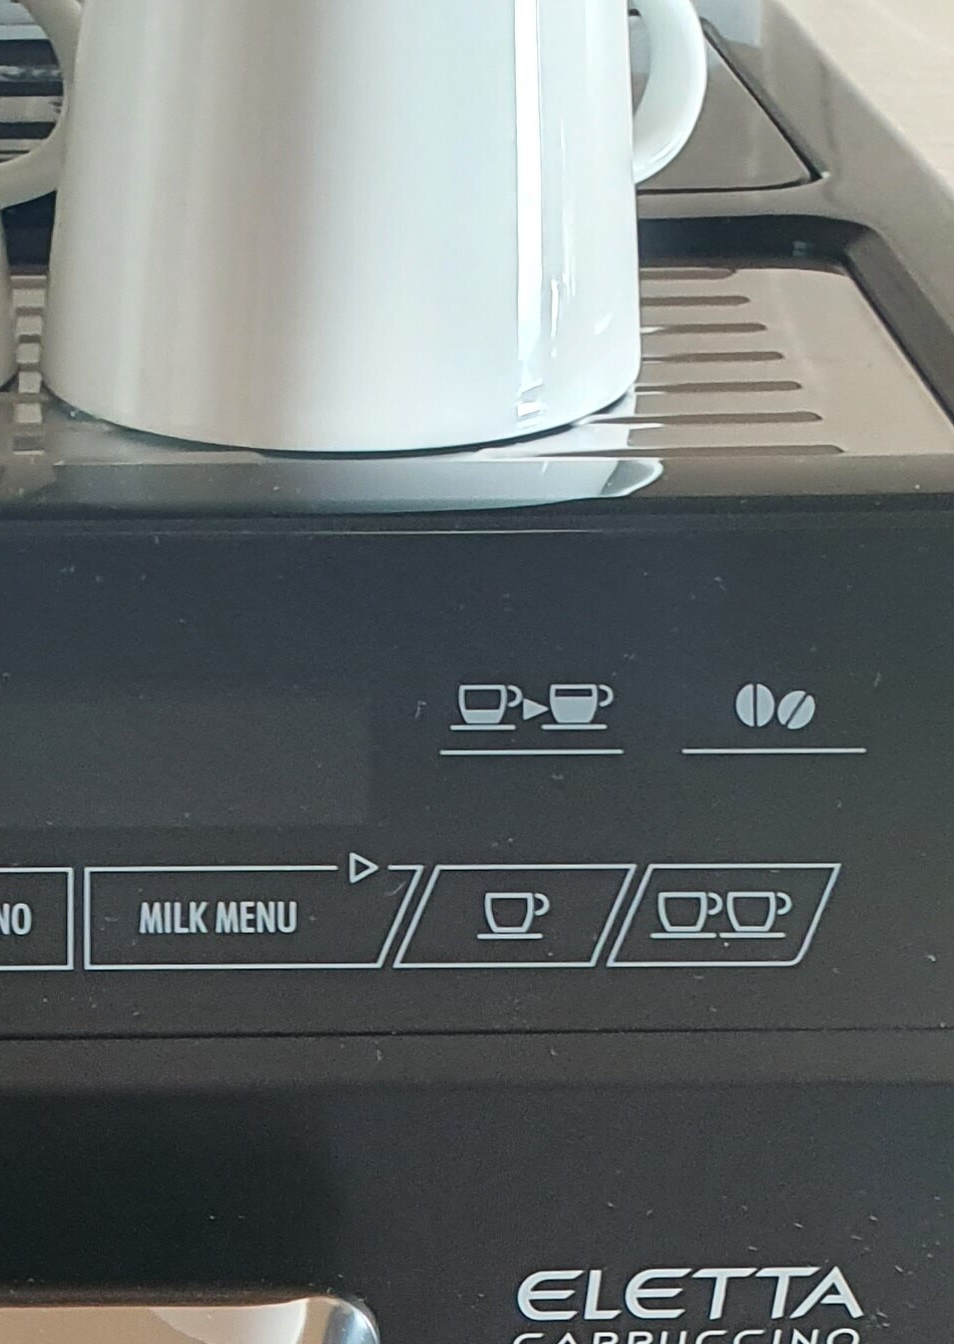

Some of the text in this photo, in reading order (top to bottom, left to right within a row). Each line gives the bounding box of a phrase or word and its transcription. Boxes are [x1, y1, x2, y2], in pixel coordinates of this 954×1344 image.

[139, 901, 297, 934] MILK MENU
[517, 1266, 864, 1321] ELETTA
